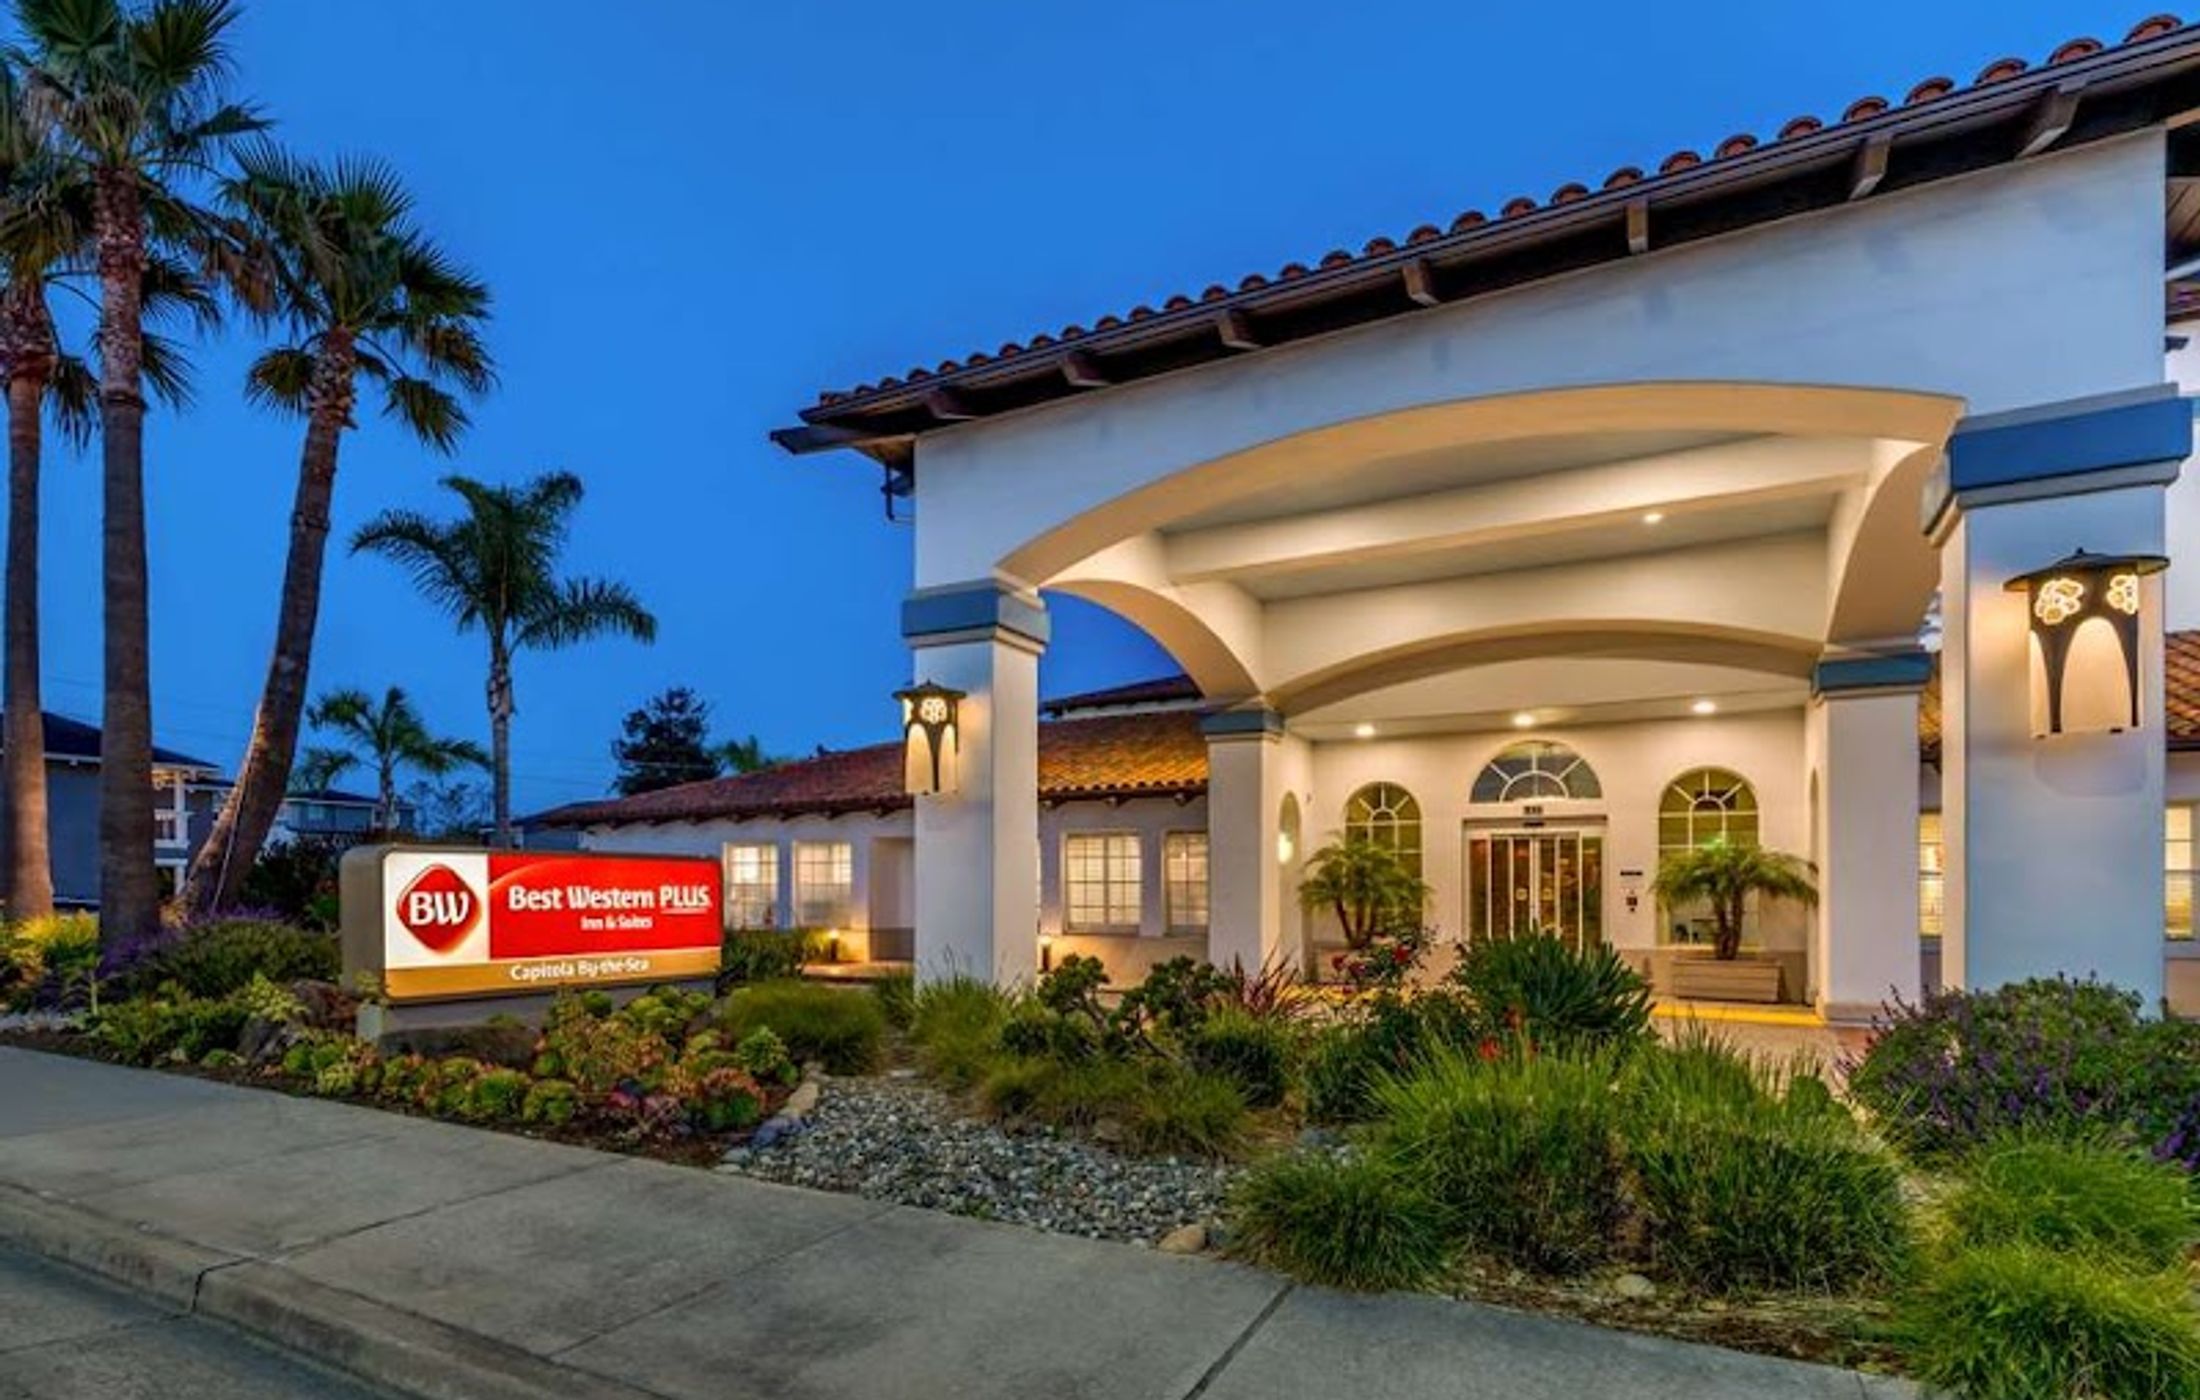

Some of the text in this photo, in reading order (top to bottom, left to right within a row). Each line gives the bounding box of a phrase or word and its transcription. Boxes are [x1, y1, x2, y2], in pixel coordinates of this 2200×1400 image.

[408, 891, 470, 926] BW
[508, 885, 711, 911] Best Western PLUS
[580, 915, 653, 931] Inn & Suites
[510, 961, 574, 981] Capitola
